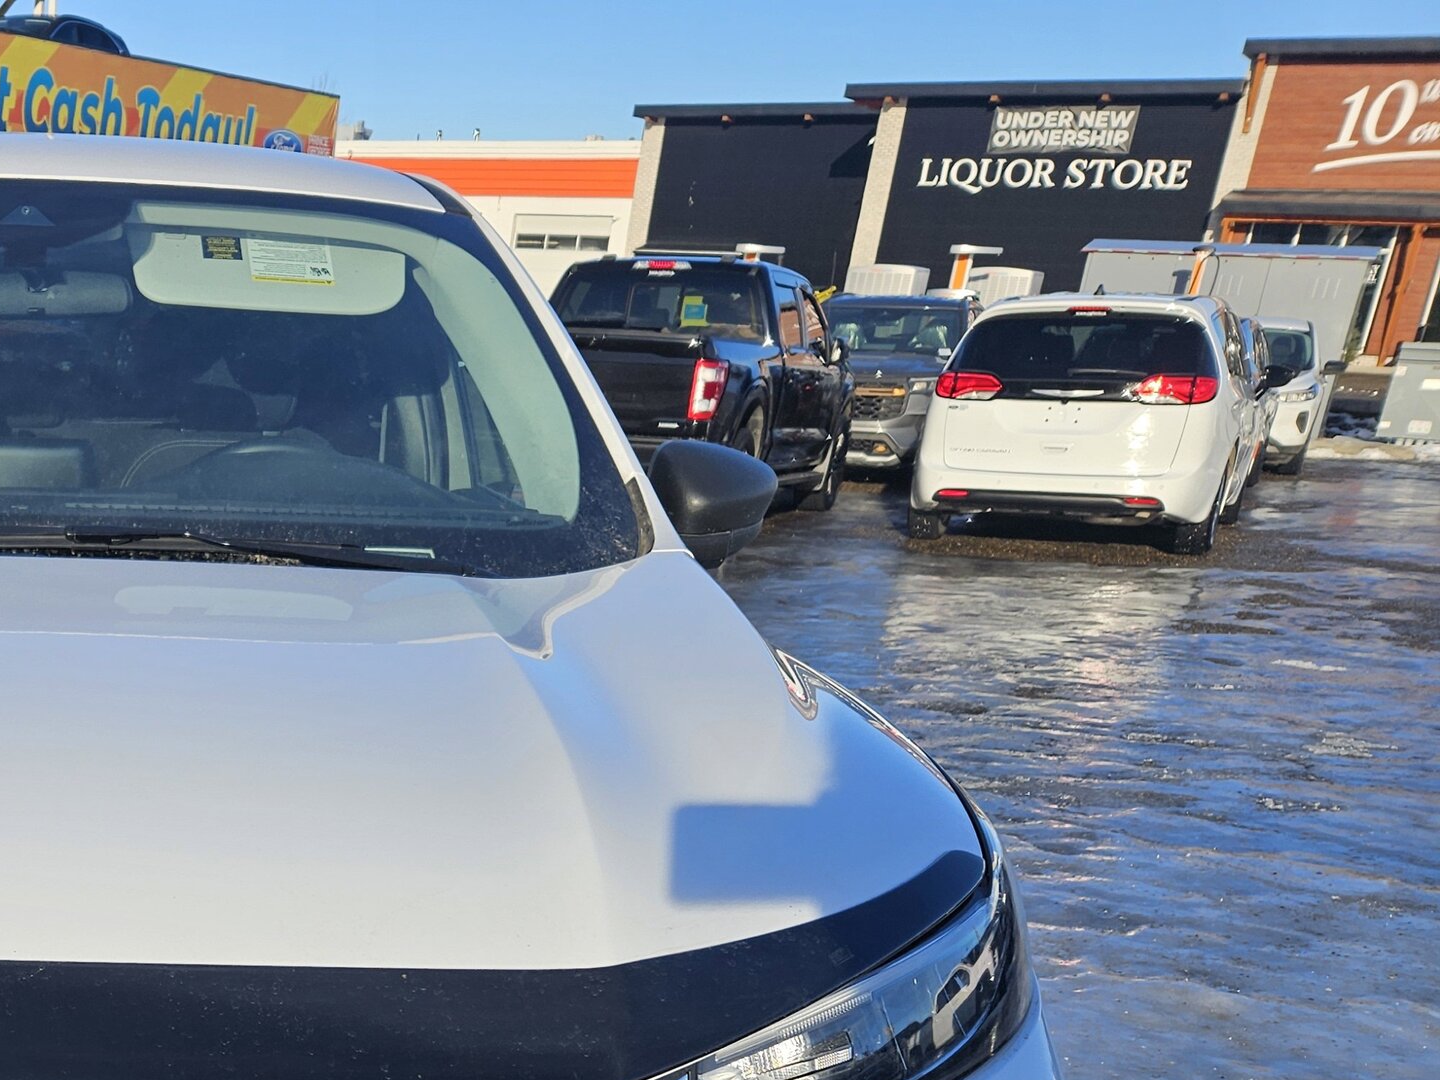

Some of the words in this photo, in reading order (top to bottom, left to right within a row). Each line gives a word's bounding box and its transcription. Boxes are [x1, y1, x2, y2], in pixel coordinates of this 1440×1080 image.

[24, 67, 124, 136] Cash
[995, 110, 1074, 129] UNDER
[1078, 110, 1135, 129] NEW
[991, 129, 1130, 148] OWNERSHIP
[915, 158, 1056, 195] LIQUOR
[1062, 158, 1193, 191] STORE
